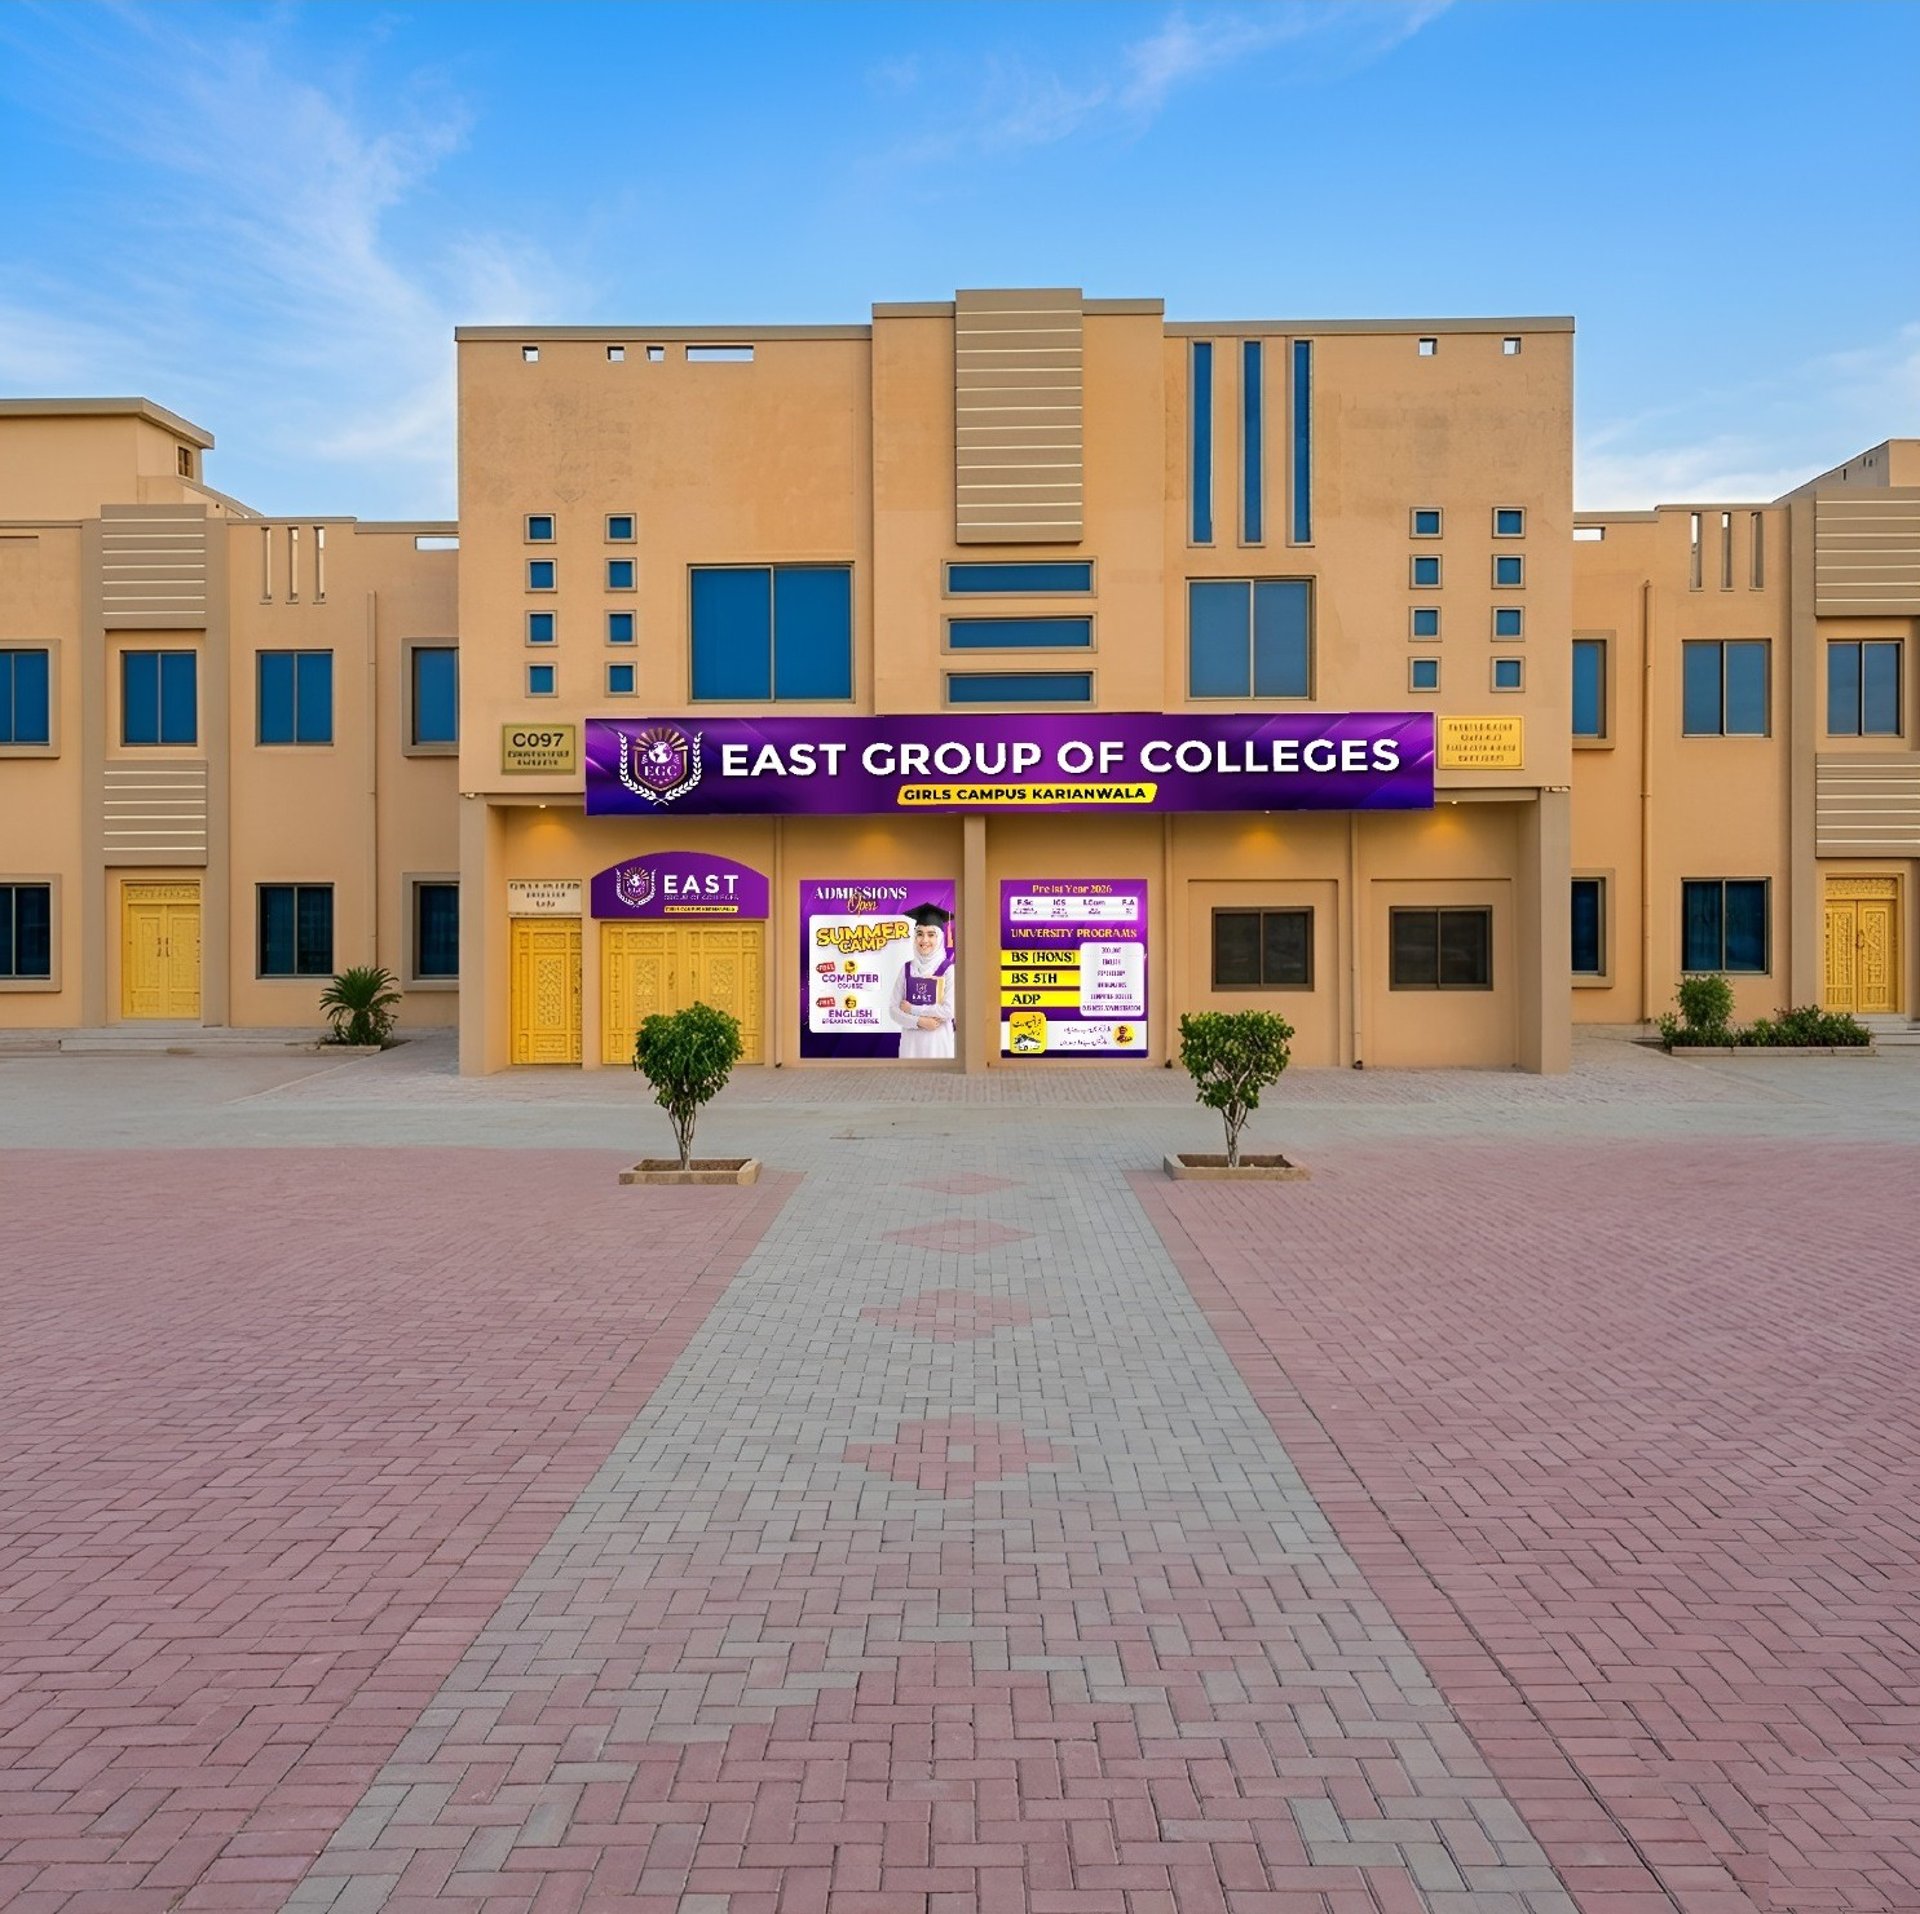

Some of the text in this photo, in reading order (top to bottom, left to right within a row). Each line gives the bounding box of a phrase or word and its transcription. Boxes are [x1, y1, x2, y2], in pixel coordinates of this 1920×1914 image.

[722, 739, 1399, 777] EAST GROUP OF COLLEGES
[644, 766, 677, 777] EGC
[904, 788, 1146, 800] GIRLS CAMPUS KARIANWALA
[664, 875, 739, 893] EAST
[1032, 885, 1050, 894] Pre
[1065, 885, 1088, 893] Year
[1091, 885, 1112, 893] 2026
[815, 886, 908, 899] ADMISSIONS
[816, 921, 910, 947] SUMMER
[1011, 929, 1137, 938] UNIVERSITY PROGRAMS
[838, 936, 887, 954] CAMP
[1012, 952, 1029, 962] BS
[822, 974, 879, 982] COMPUTER
[1012, 973, 1057, 983] BS 5TH
[1011, 994, 1041, 1005] ADP
[829, 1010, 872, 1018] ENGLISH
